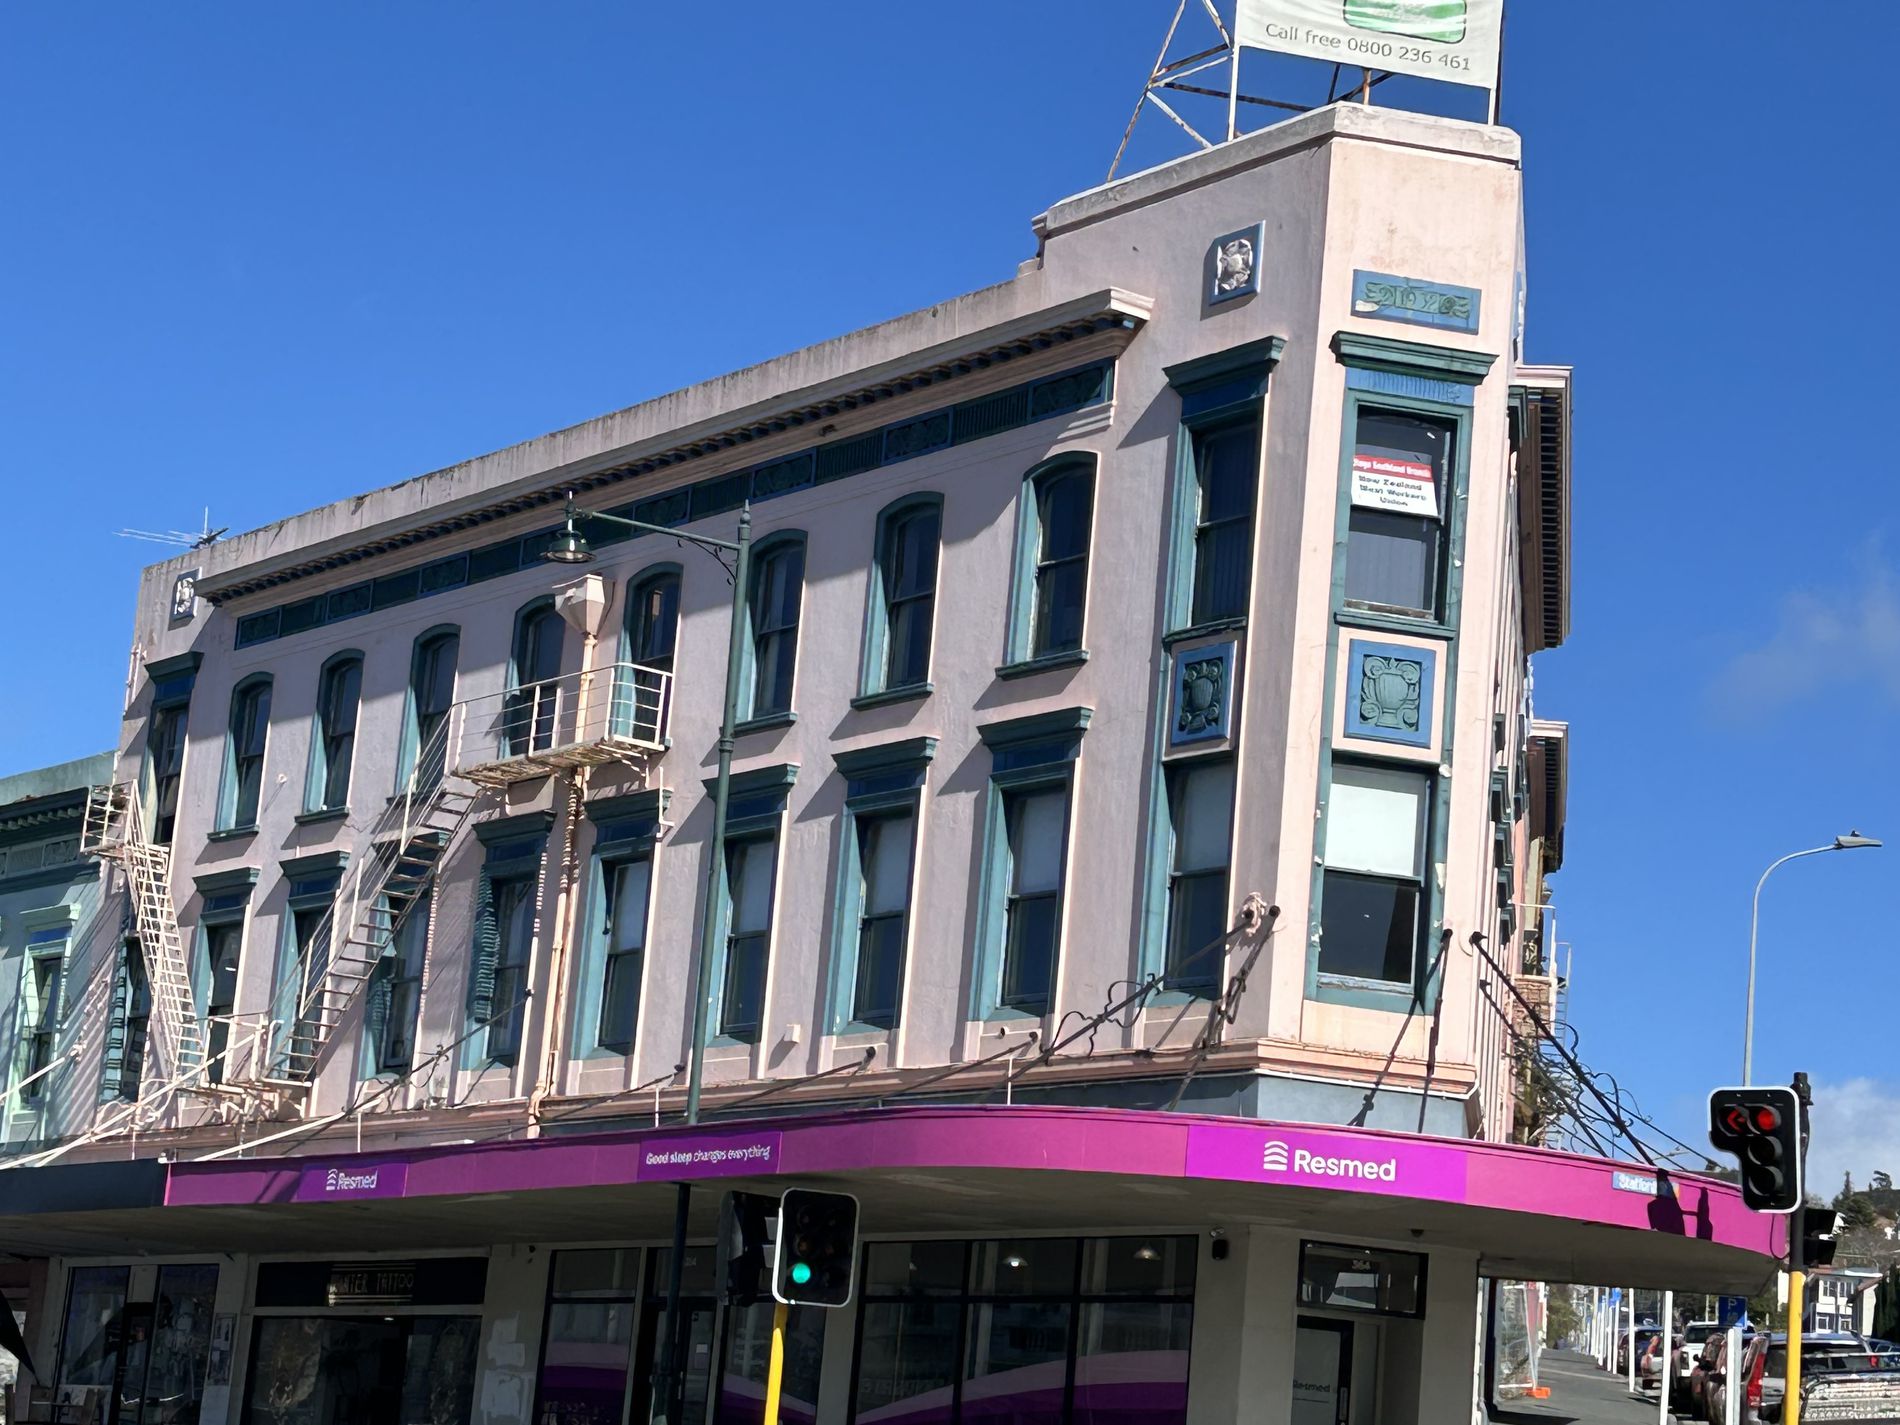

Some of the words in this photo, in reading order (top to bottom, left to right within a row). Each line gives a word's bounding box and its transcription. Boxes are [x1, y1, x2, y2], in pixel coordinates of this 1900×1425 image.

[1265, 22, 1298, 41] Call
[1306, 30, 1341, 49] free
[1347, 37, 1392, 57] 0800
[1399, 46, 1432, 64] 236
[1438, 53, 1471, 71] 461
[1358, 475, 1380, 485] New
[1383, 479, 1422, 491] Zealand
[1386, 489, 1427, 501] Workers
[646, 1152, 668, 1165] Good
[670, 1151, 693, 1165] sleep
[694, 1149, 726, 1163] changes
[728, 1145, 771, 1161] everything
[1294, 1149, 1396, 1181] Resmed
[337, 1168, 378, 1190] Resmed
[376, 1272, 414, 1293] TATTOO
